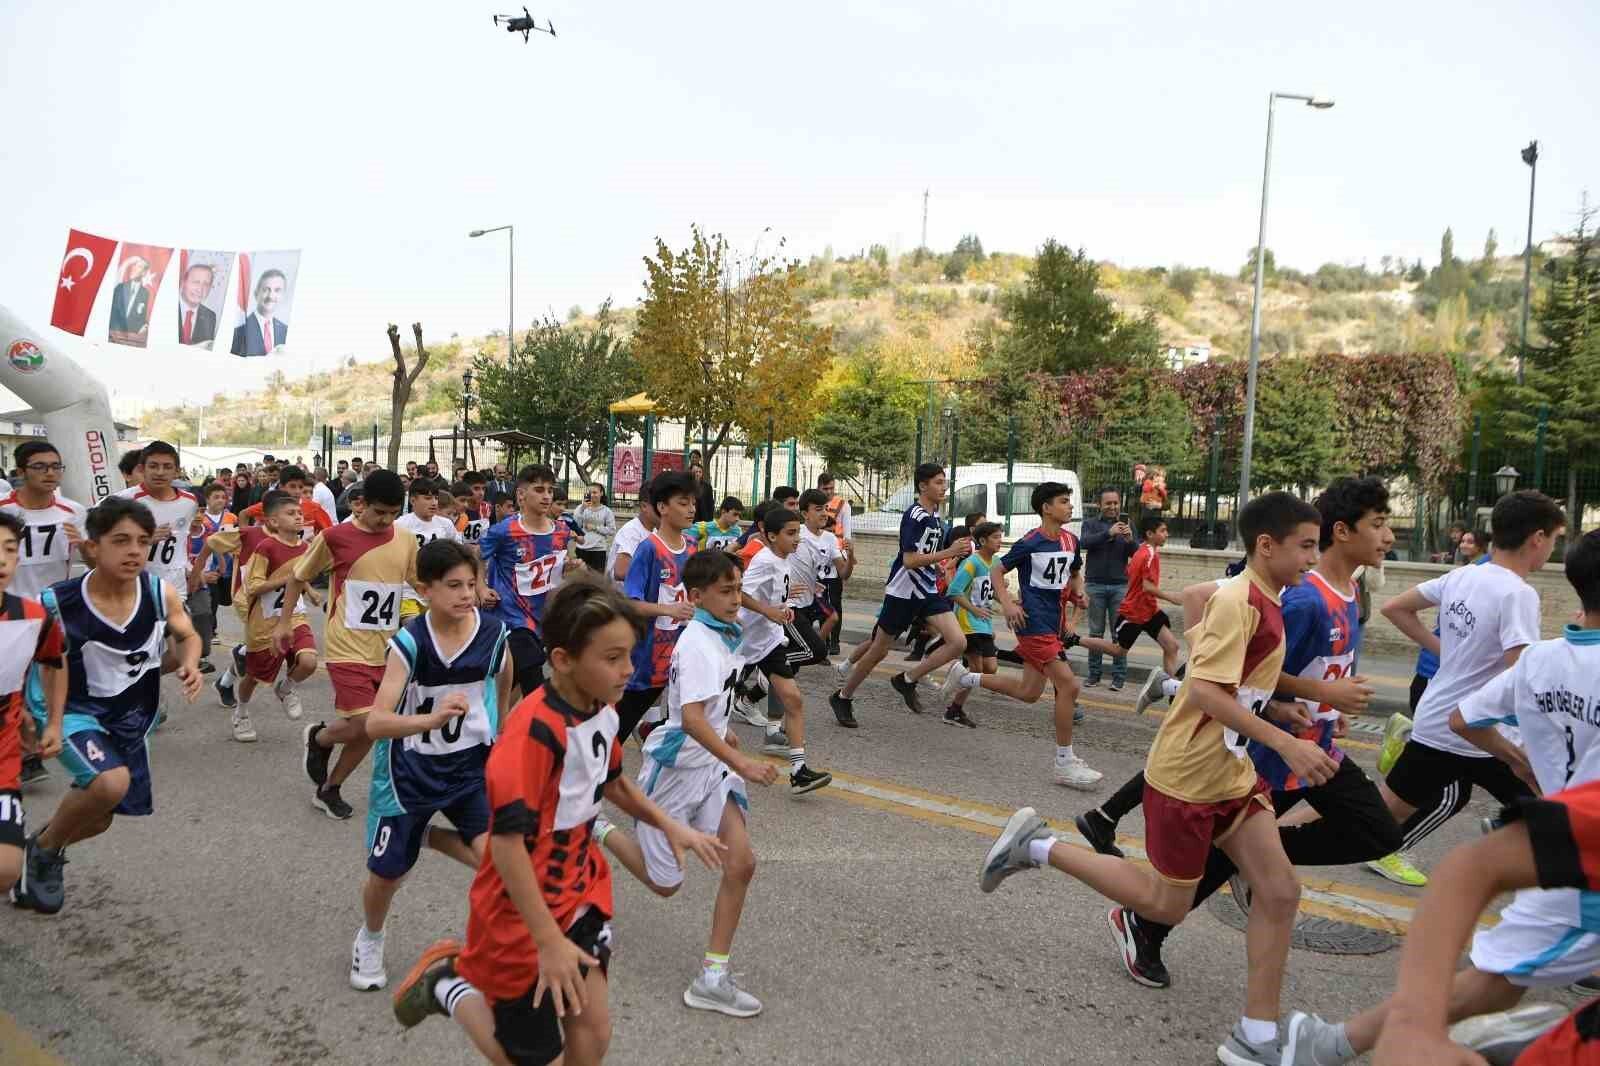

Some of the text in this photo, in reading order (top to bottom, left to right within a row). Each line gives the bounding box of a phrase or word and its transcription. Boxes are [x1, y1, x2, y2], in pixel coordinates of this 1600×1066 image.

[22, 524, 57, 557] 17
[463, 523, 482, 540] 46
[529, 556, 557, 590] 27
[1043, 556, 1068, 585] 47
[360, 590, 396, 625] 24
[125, 650, 150, 677] 9
[86, 740, 106, 763] 4
[373, 826, 391, 857] 9
